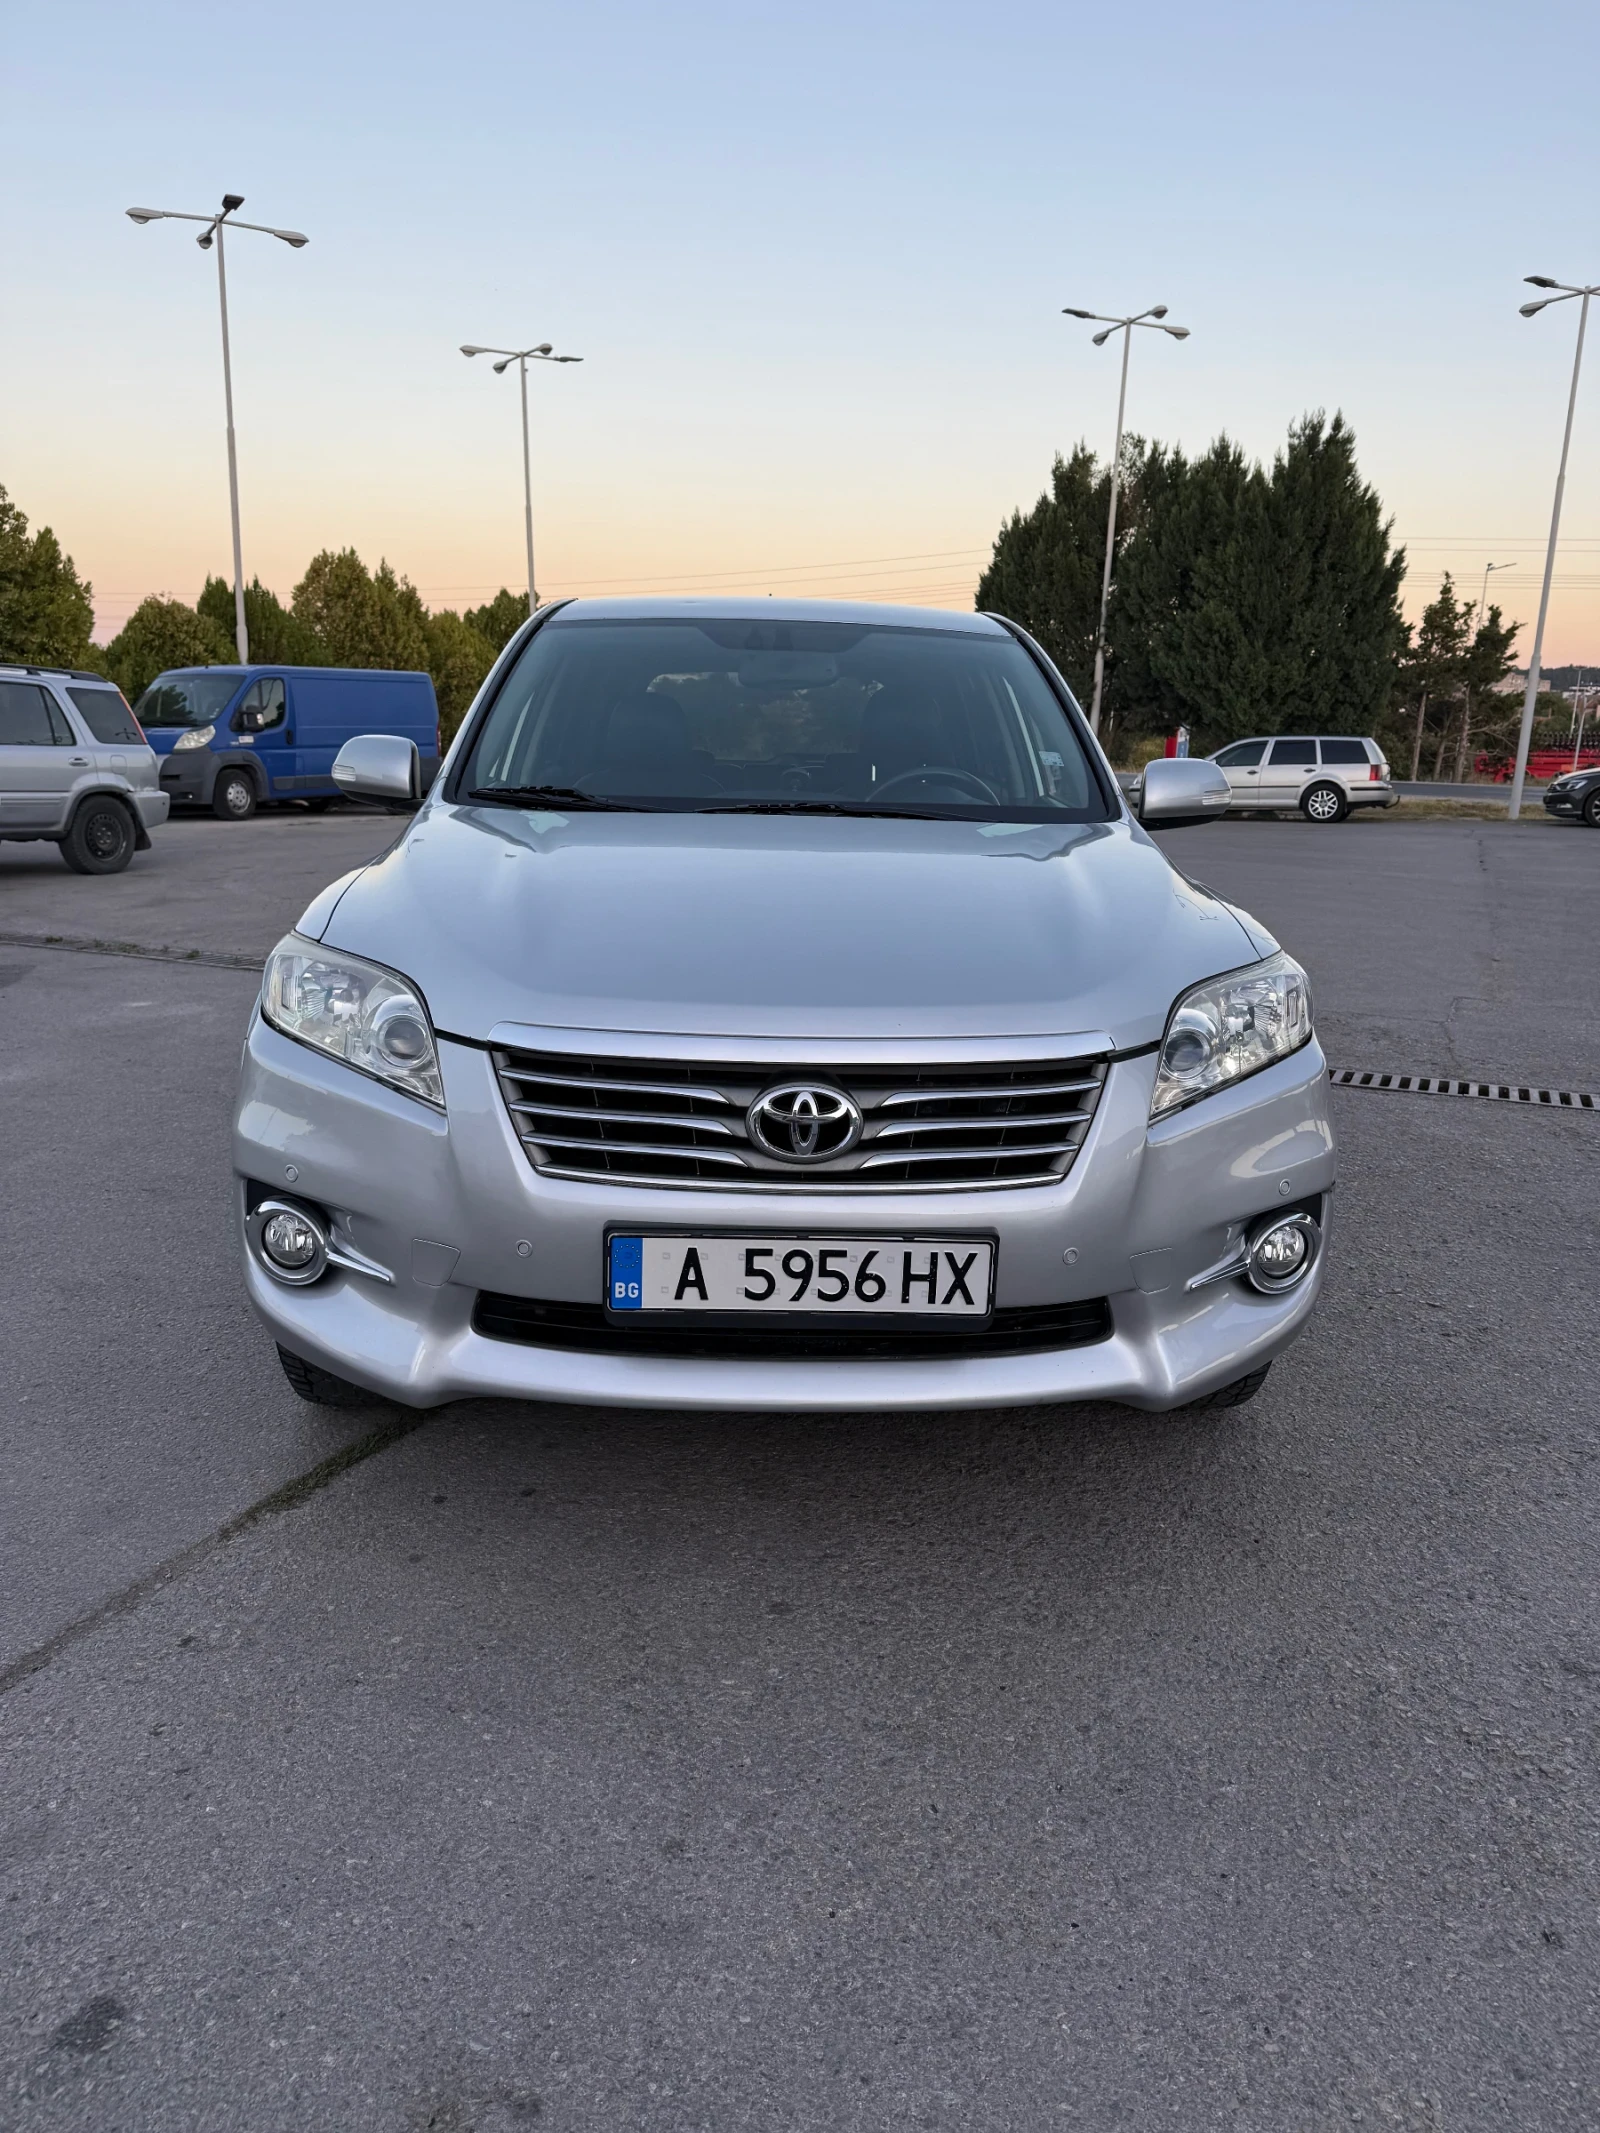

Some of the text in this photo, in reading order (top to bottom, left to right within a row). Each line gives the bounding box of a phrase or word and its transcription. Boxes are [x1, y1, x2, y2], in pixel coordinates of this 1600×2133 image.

[614, 1281, 639, 1299] BG
[674, 1247, 979, 1305] A 5956 HX
